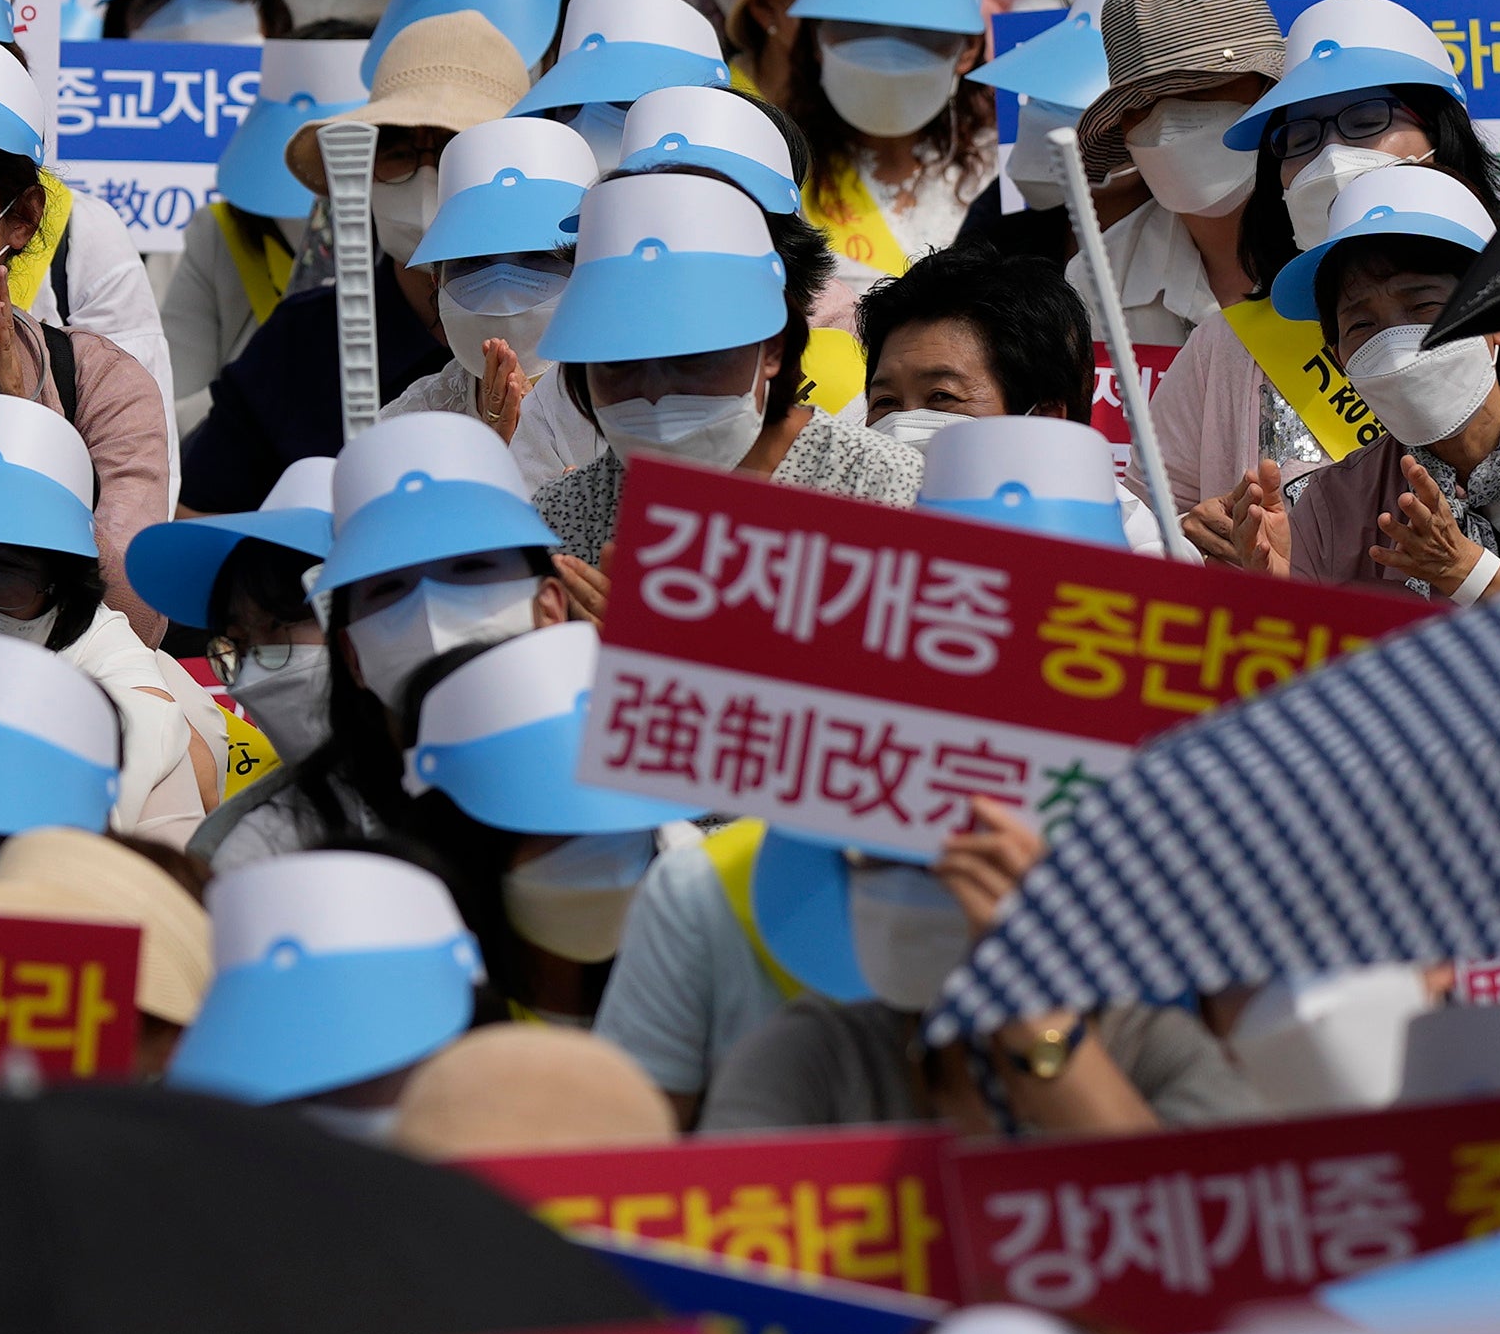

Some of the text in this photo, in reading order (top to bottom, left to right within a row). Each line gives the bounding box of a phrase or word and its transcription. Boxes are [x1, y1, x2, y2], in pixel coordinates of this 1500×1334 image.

[64, 175, 220, 232] 教の
[636, 503, 1363, 715] 강제개종 중단하
[535, 1174, 943, 1294] 단하라
[986, 1147, 1421, 1310] 강제개종
